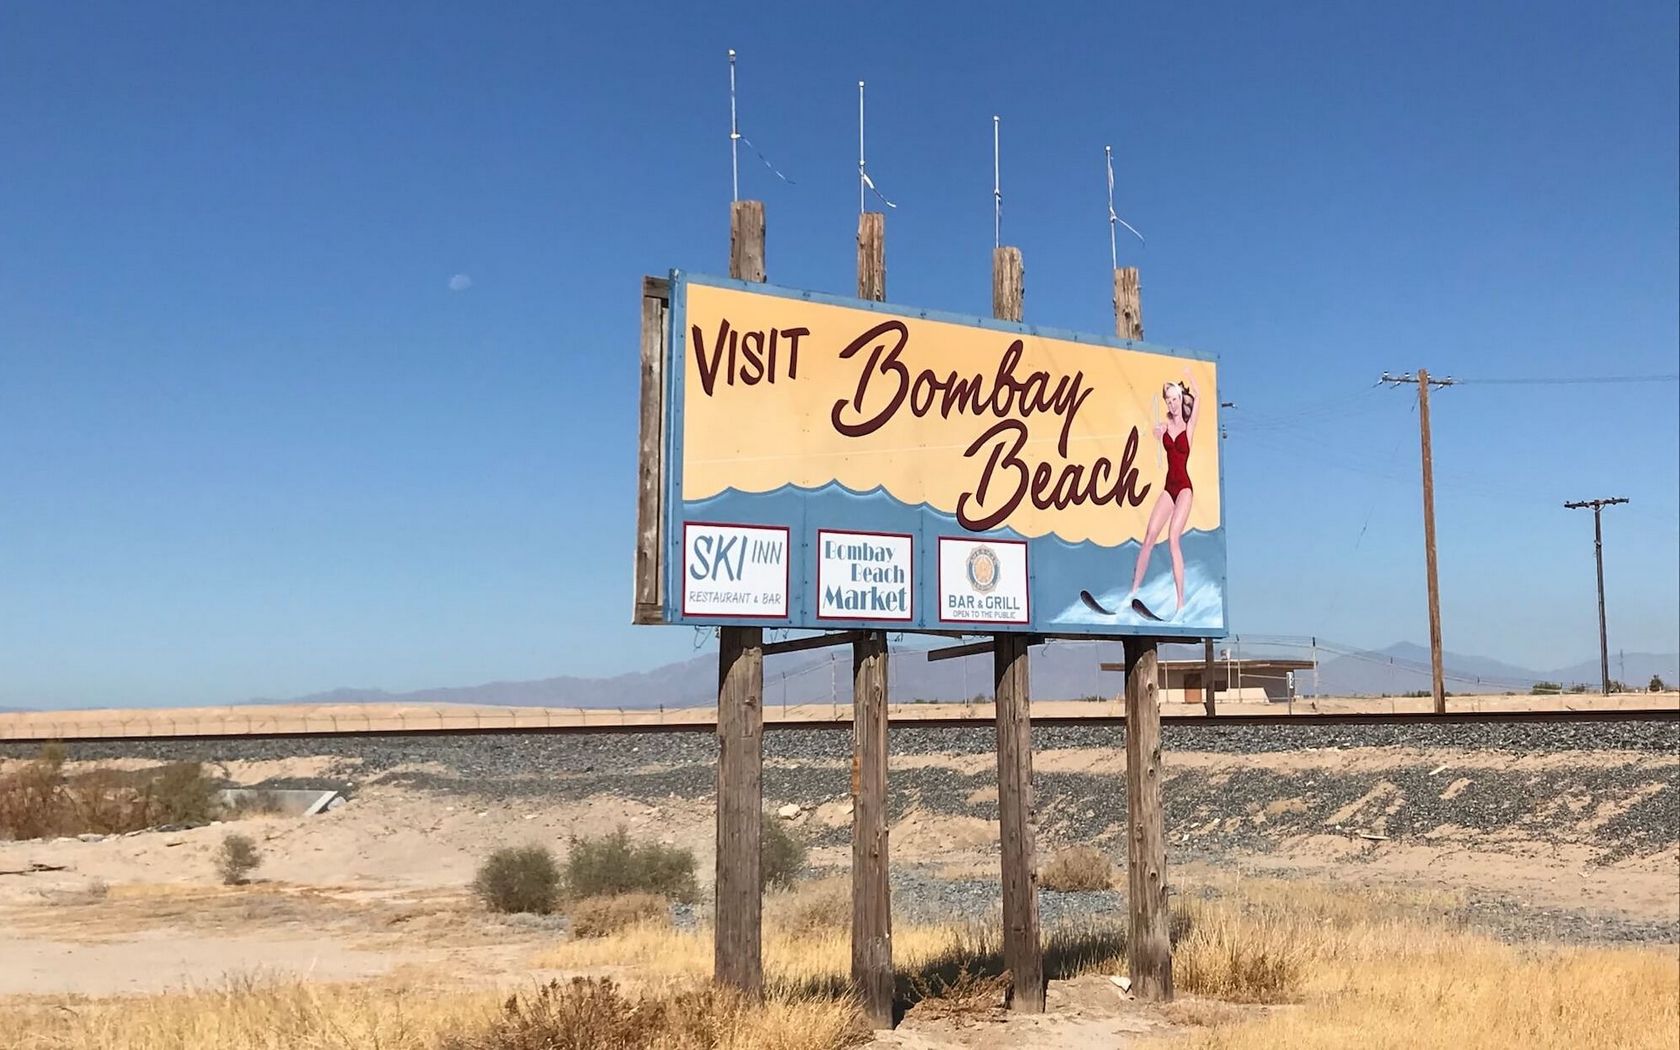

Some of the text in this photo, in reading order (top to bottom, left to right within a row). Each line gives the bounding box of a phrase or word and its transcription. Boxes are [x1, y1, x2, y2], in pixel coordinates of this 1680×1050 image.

[691, 318, 1094, 458] VISIT Bombay
[955, 418, 1151, 533] Beach
[689, 534, 783, 581] SKI INN
[825, 540, 896, 563] Bombay
[851, 563, 905, 584] Beach
[689, 591, 751, 604] RESTAURANT
[762, 592, 782, 605] BAR
[822, 584, 908, 612] Market
[948, 594, 1020, 610] BAR & GRILL
[952, 609, 970, 618] OPEN
[971, 610, 980, 618] TO
[981, 611, 993, 619] THE
